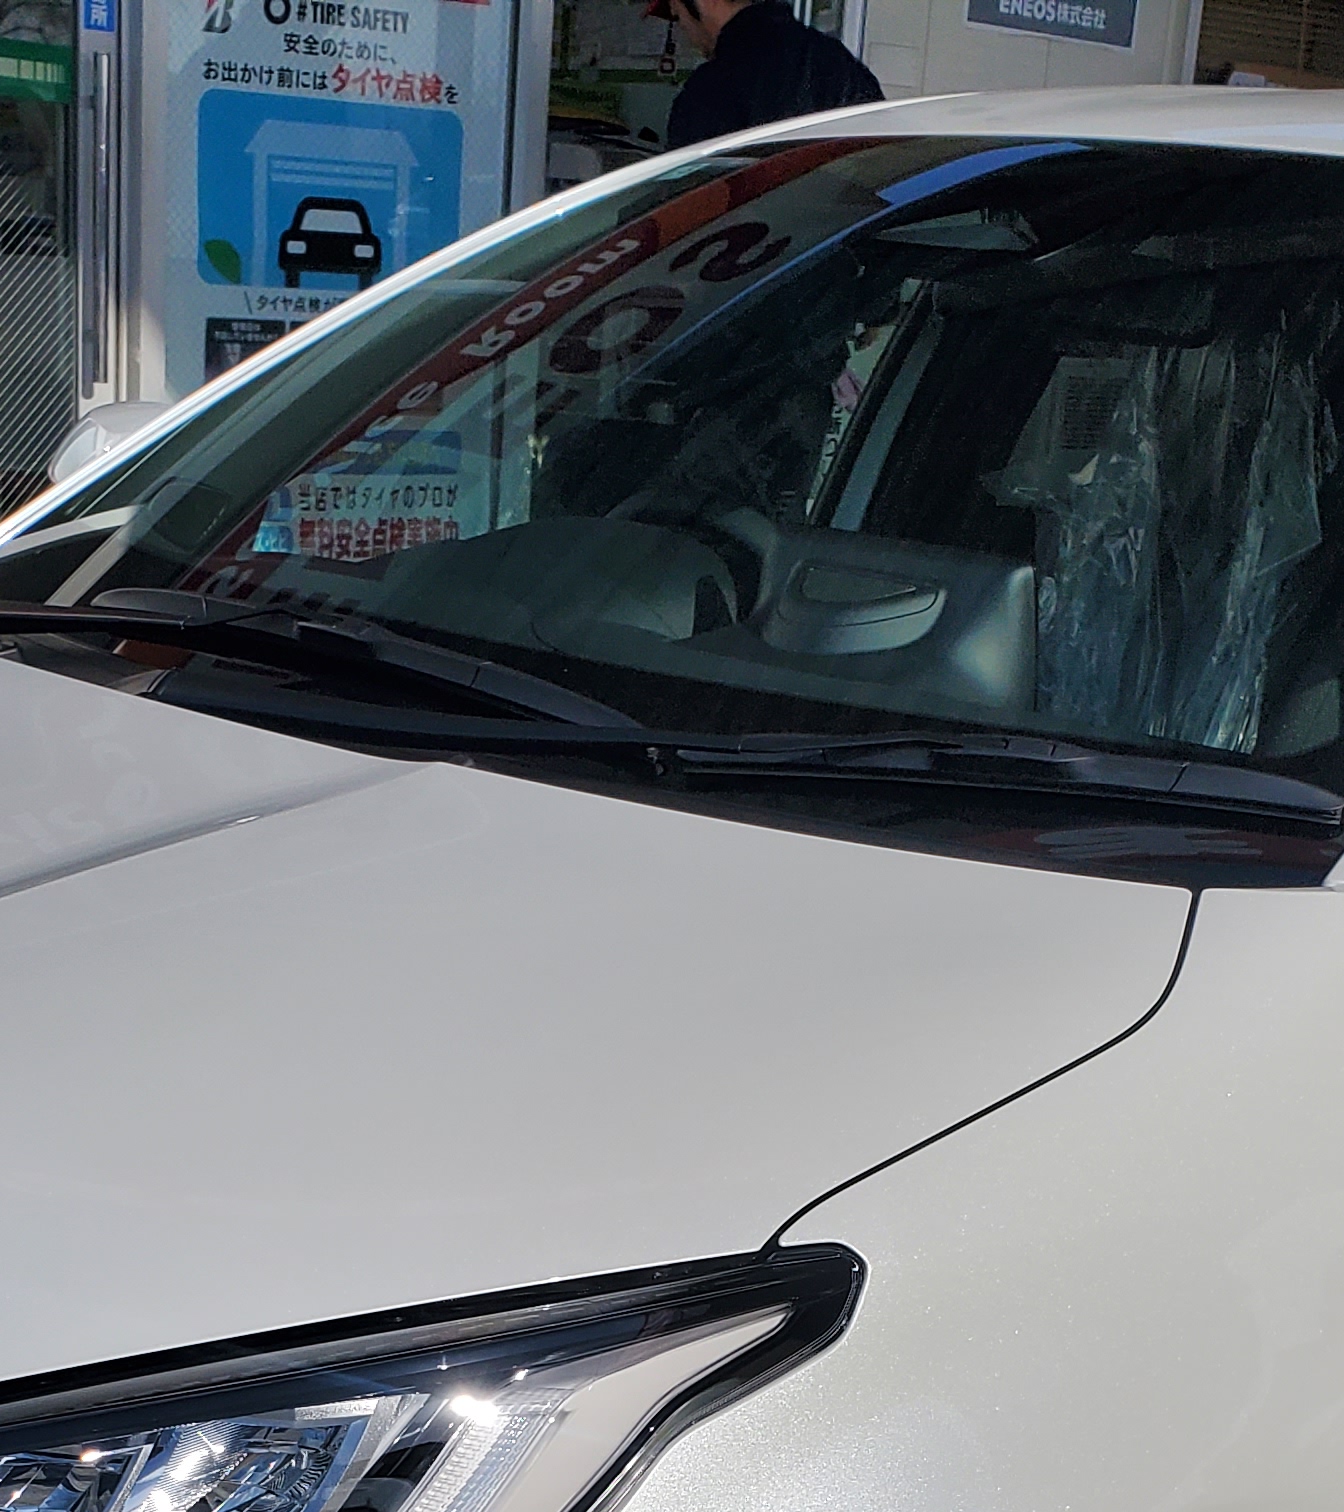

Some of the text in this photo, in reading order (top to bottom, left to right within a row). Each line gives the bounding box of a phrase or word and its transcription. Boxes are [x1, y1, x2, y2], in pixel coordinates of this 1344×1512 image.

[352, 10, 410, 35] SAFETY
[283, 31, 398, 65] 安全のために、
[202, 58, 460, 105] お出かけ前にはタイヤ点検を
